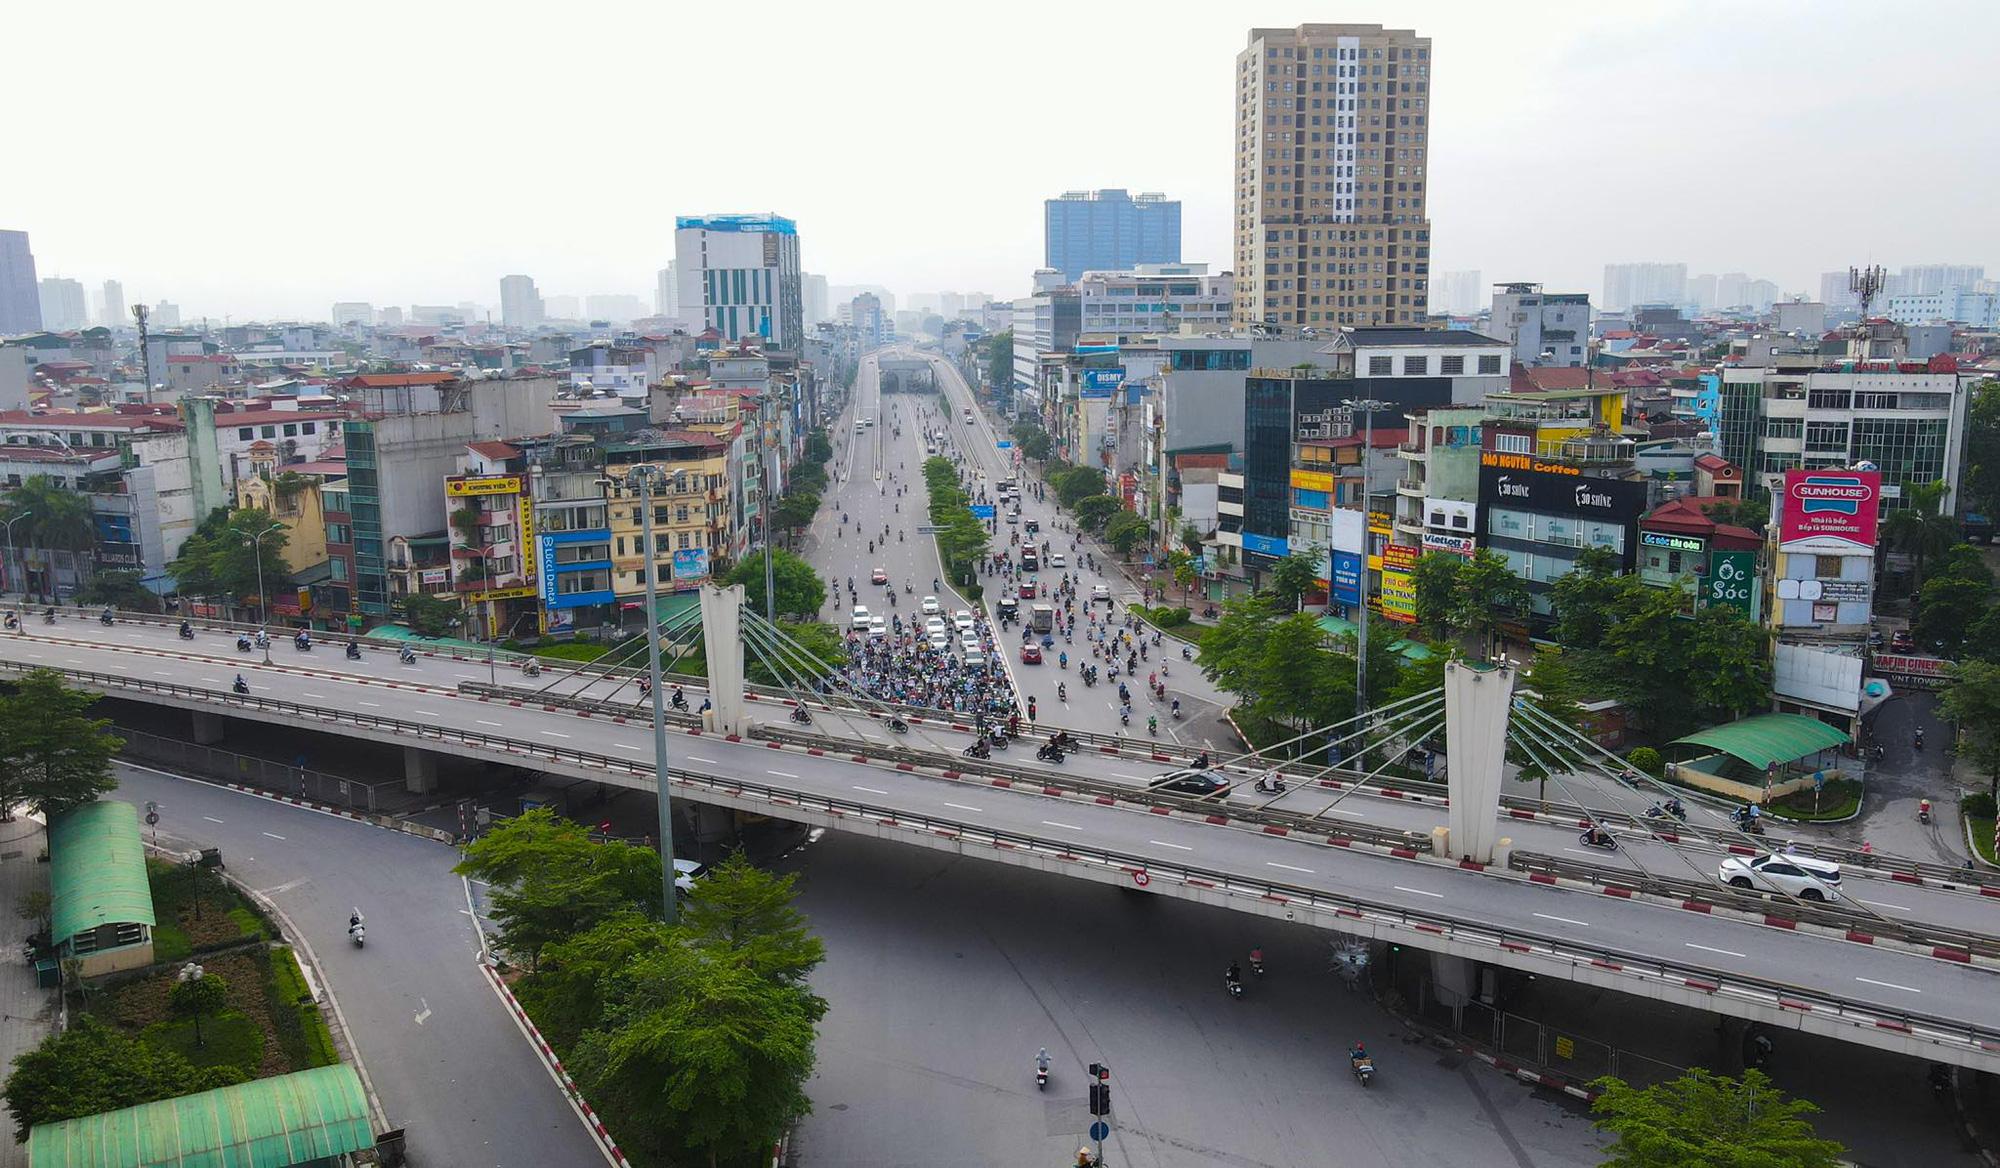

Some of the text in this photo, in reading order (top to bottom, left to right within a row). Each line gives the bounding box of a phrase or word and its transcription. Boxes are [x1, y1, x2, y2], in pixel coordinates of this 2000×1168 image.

[1097, 373, 1121, 382] DISMY
[1500, 454, 1531, 470] NGUYÊN
[1533, 462, 1580, 476] Coffee
[1800, 487, 1863, 497] SUNHOUSE
[1581, 494, 1590, 504] 30
[1834, 516, 1848, 524] bếp
[1798, 522, 1812, 531] Bếp
[102, 553, 124, 564] BILLIARDS
[547, 574, 558, 605] Dental
